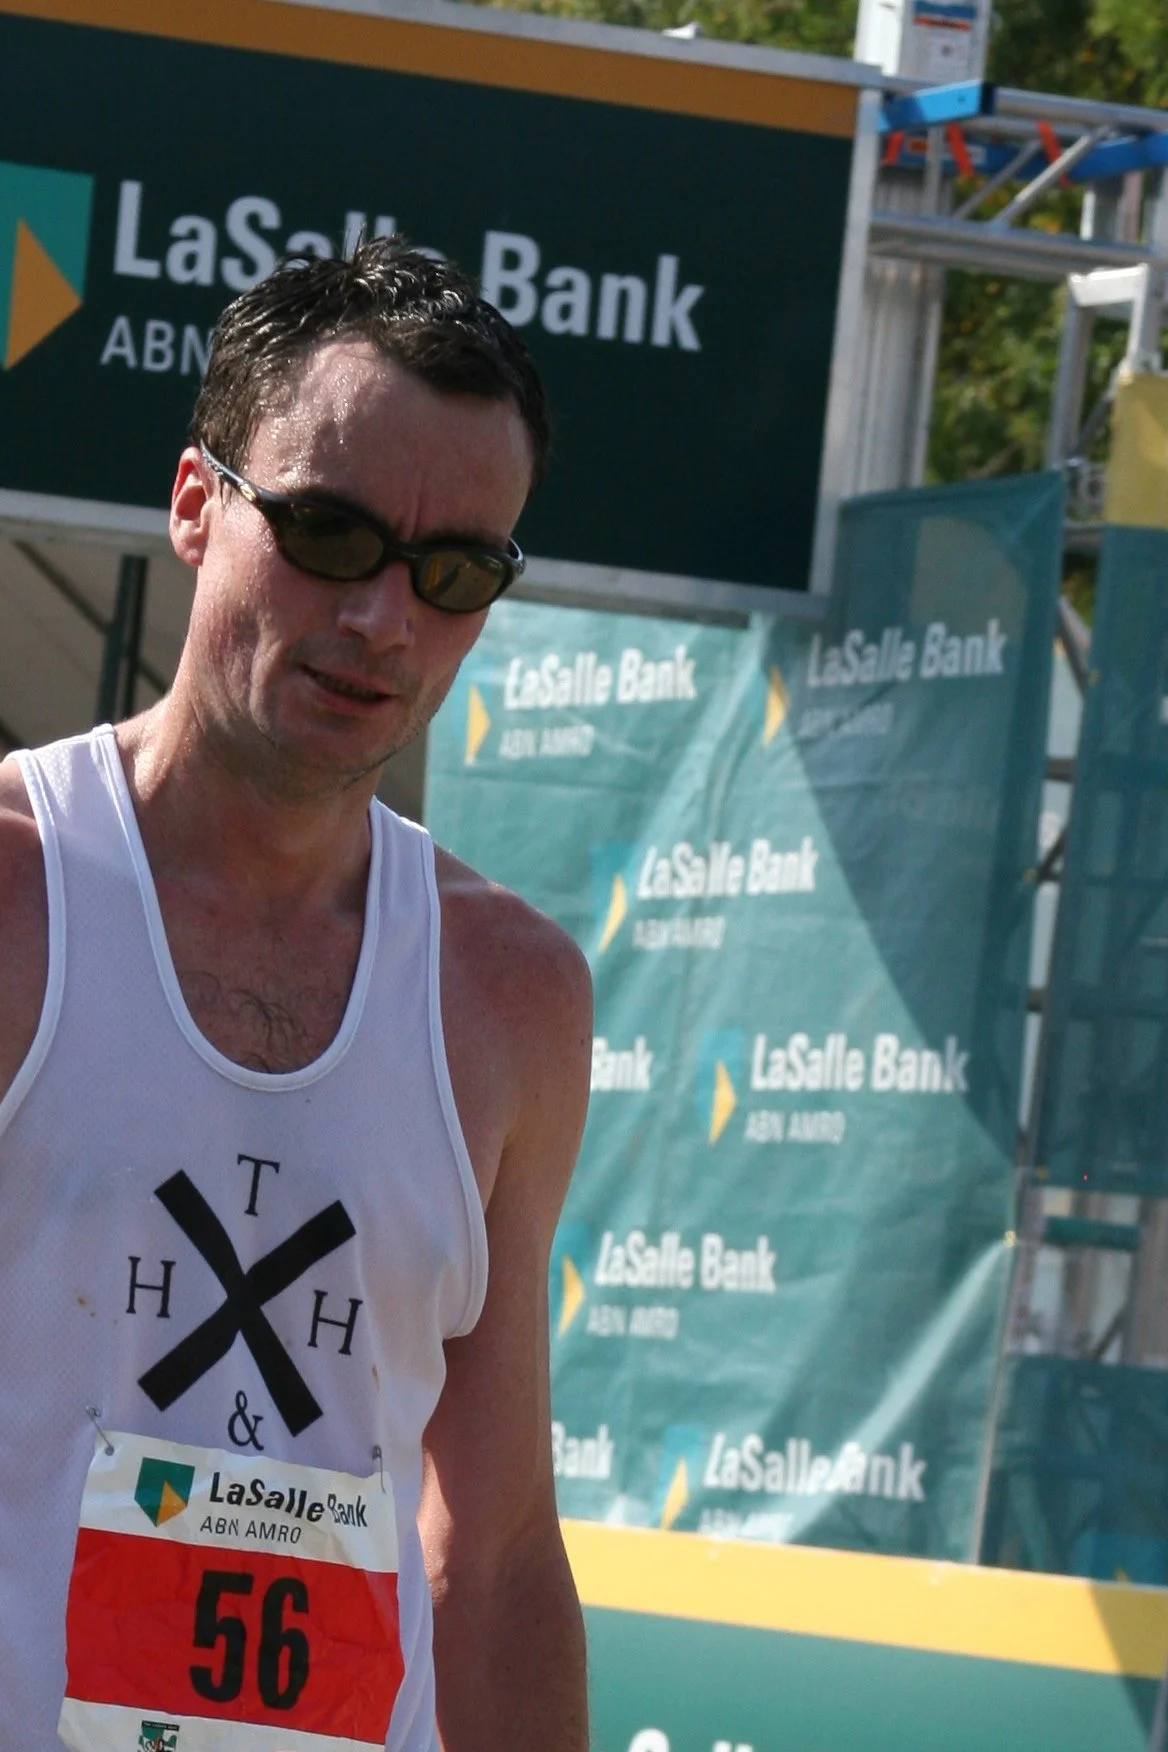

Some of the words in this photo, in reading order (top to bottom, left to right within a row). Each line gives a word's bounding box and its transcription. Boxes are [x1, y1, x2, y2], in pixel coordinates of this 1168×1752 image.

[482, 230, 705, 352] Bank
[504, 653, 613, 712] LaSalle
[616, 644, 698, 704] Bank
[807, 626, 916, 688] LaSalle
[920, 617, 1006, 679] Bank
[636, 840, 746, 899] LaSalle
[746, 835, 818, 894] Bank
[750, 1033, 865, 1092] LaSalle
[871, 1033, 969, 1094] Bank
[237, 1153, 280, 1217] T
[126, 1255, 176, 1319] H
[593, 1229, 696, 1291] LaSalle
[699, 1232, 778, 1295] Bank
[307, 1290, 363, 1356] H
[227, 1390, 265, 1451] &
[208, 1470, 326, 1524] LaSalle
[200, 1516, 240, 1535] ABN
[245, 1524, 302, 1545] AMRO
[189, 1568, 311, 1710] 56
